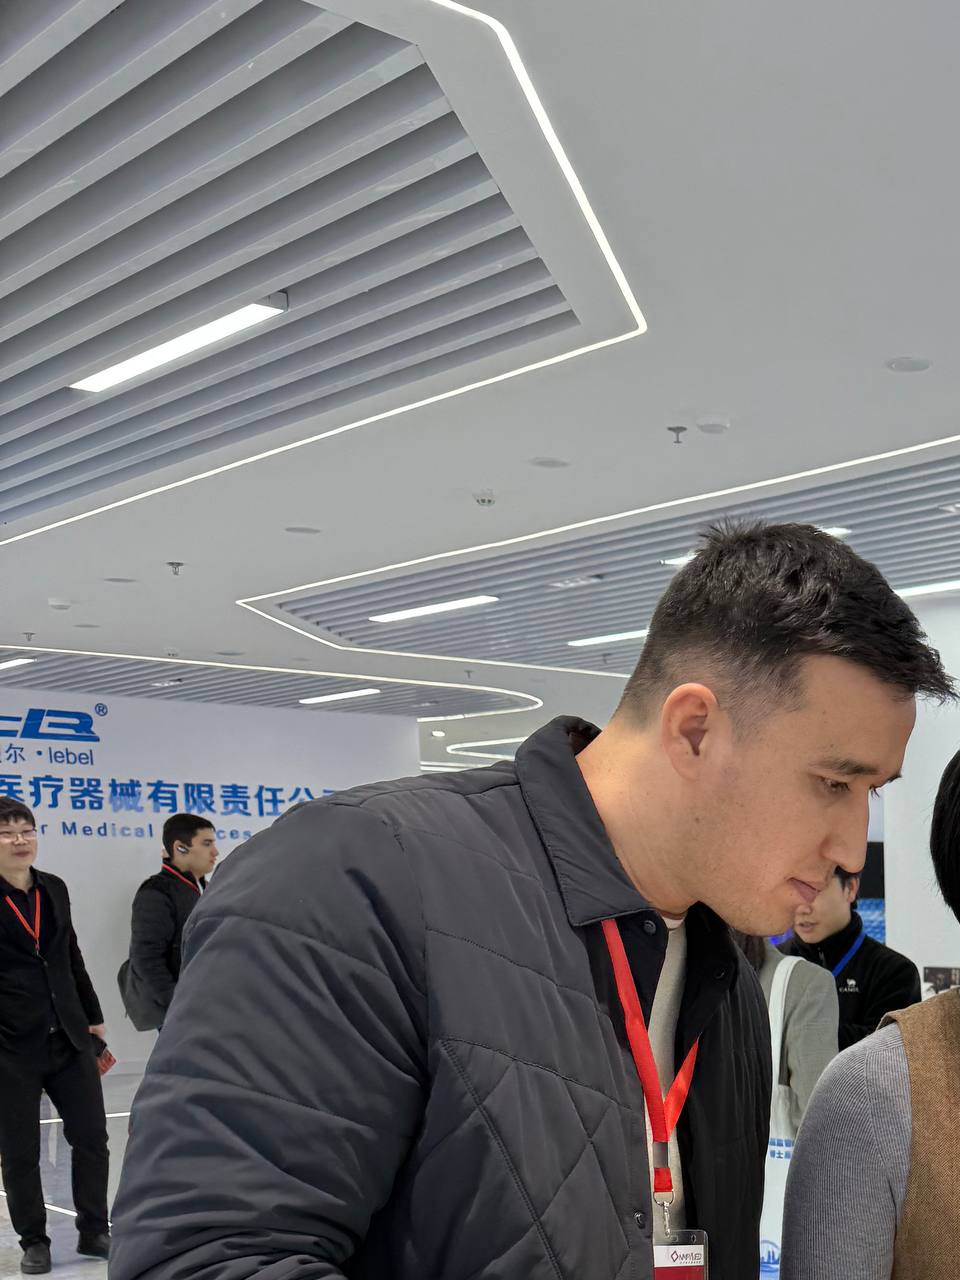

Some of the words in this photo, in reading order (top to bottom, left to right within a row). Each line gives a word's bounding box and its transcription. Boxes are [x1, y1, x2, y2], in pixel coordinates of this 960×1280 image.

[0, 774, 335, 817] 医疗器械有限责任公
[62, 821, 153, 838] Medical
